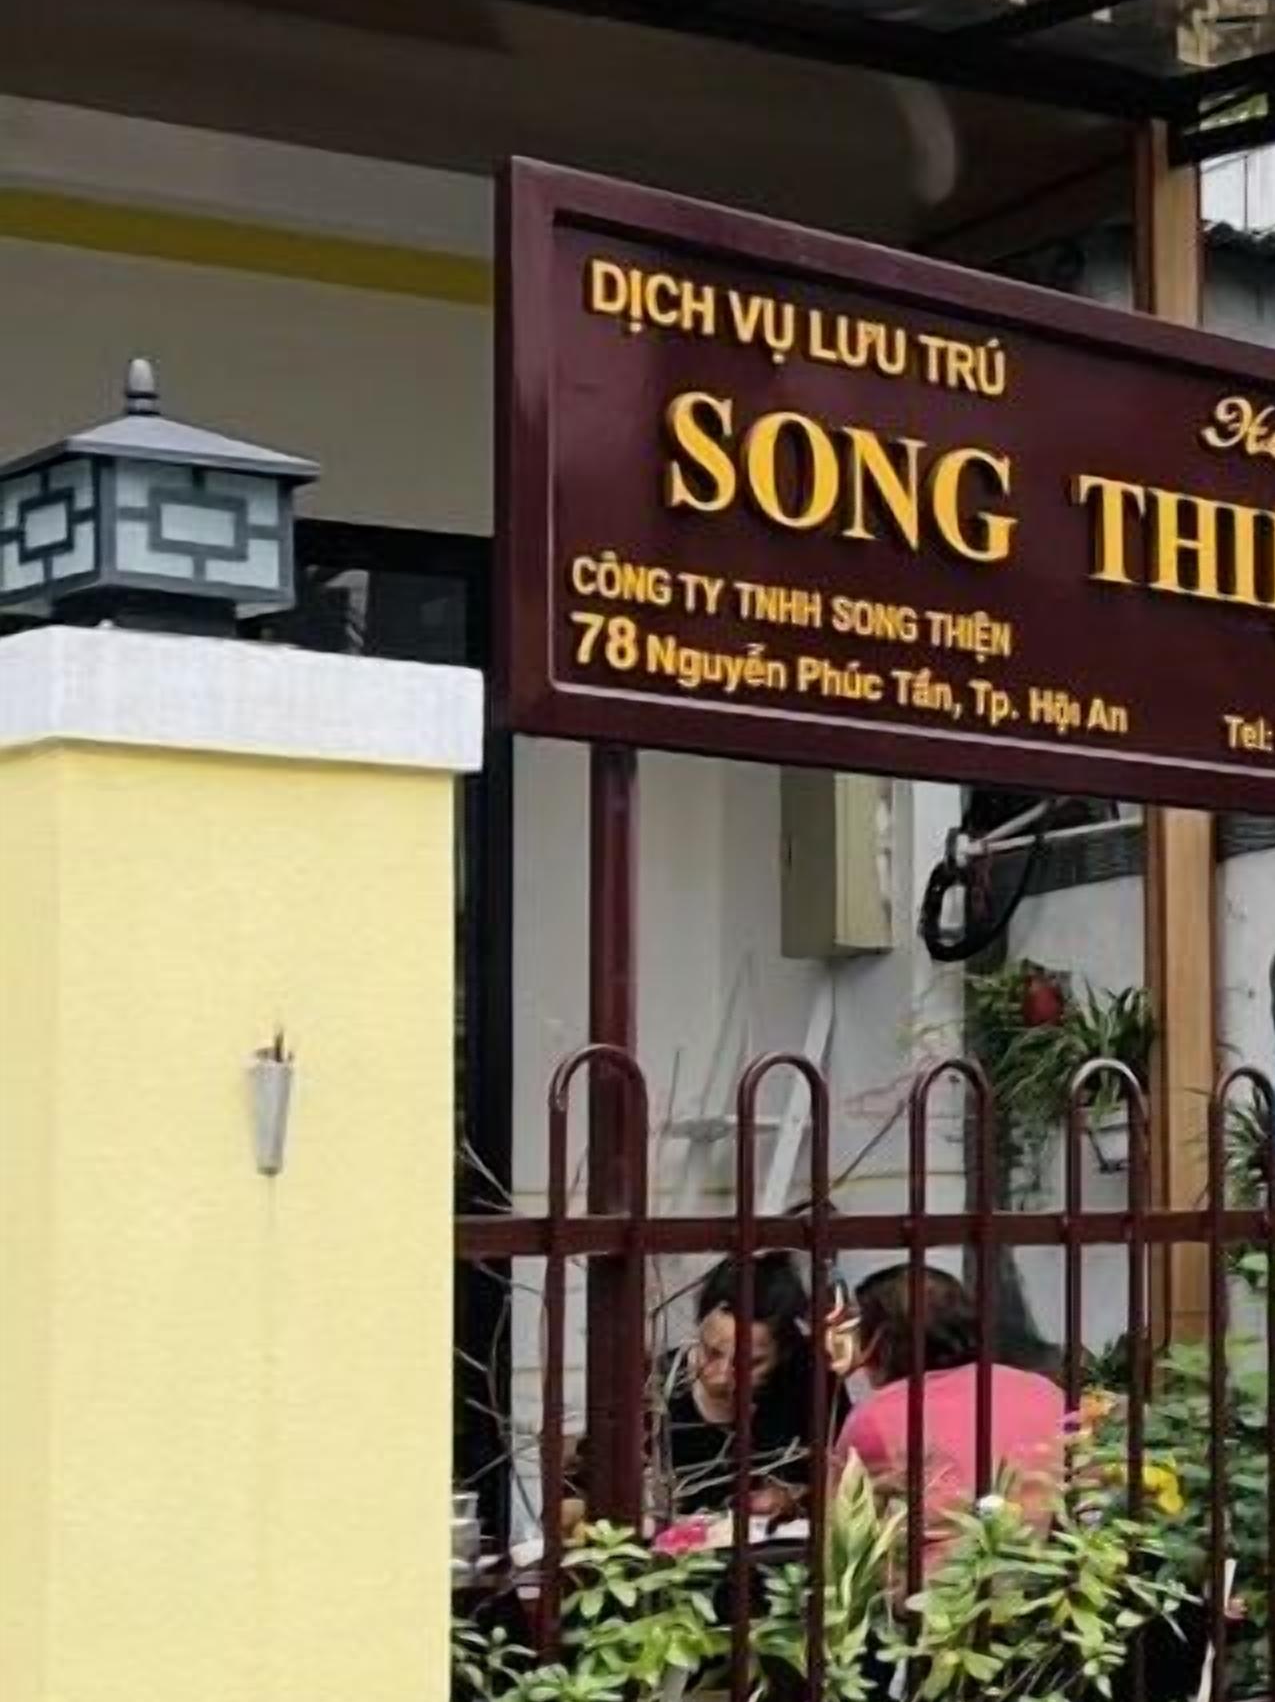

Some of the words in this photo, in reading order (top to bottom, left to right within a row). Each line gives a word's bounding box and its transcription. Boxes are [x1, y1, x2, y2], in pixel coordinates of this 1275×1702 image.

[591, 259, 716, 335] DỊCH
[729, 291, 795, 364] VỤ
[808, 309, 906, 375] LƯU
[918, 334, 1006, 395] TRÚ
[667, 391, 1018, 562] SONG
[571, 550, 673, 607] CÔNG
[677, 571, 724, 614] TY
[733, 582, 822, 628] TNHH
[831, 595, 919, 643] SONG
[925, 610, 1012, 663] THIỆN
[570, 610, 639, 671] 78
[797, 656, 884, 701] Phúc
[968, 678, 1020, 726] Tp.
[1028, 686, 1081, 734] Hội
[1087, 698, 1129, 733] An
[1223, 714, 1273, 752] Tel:
